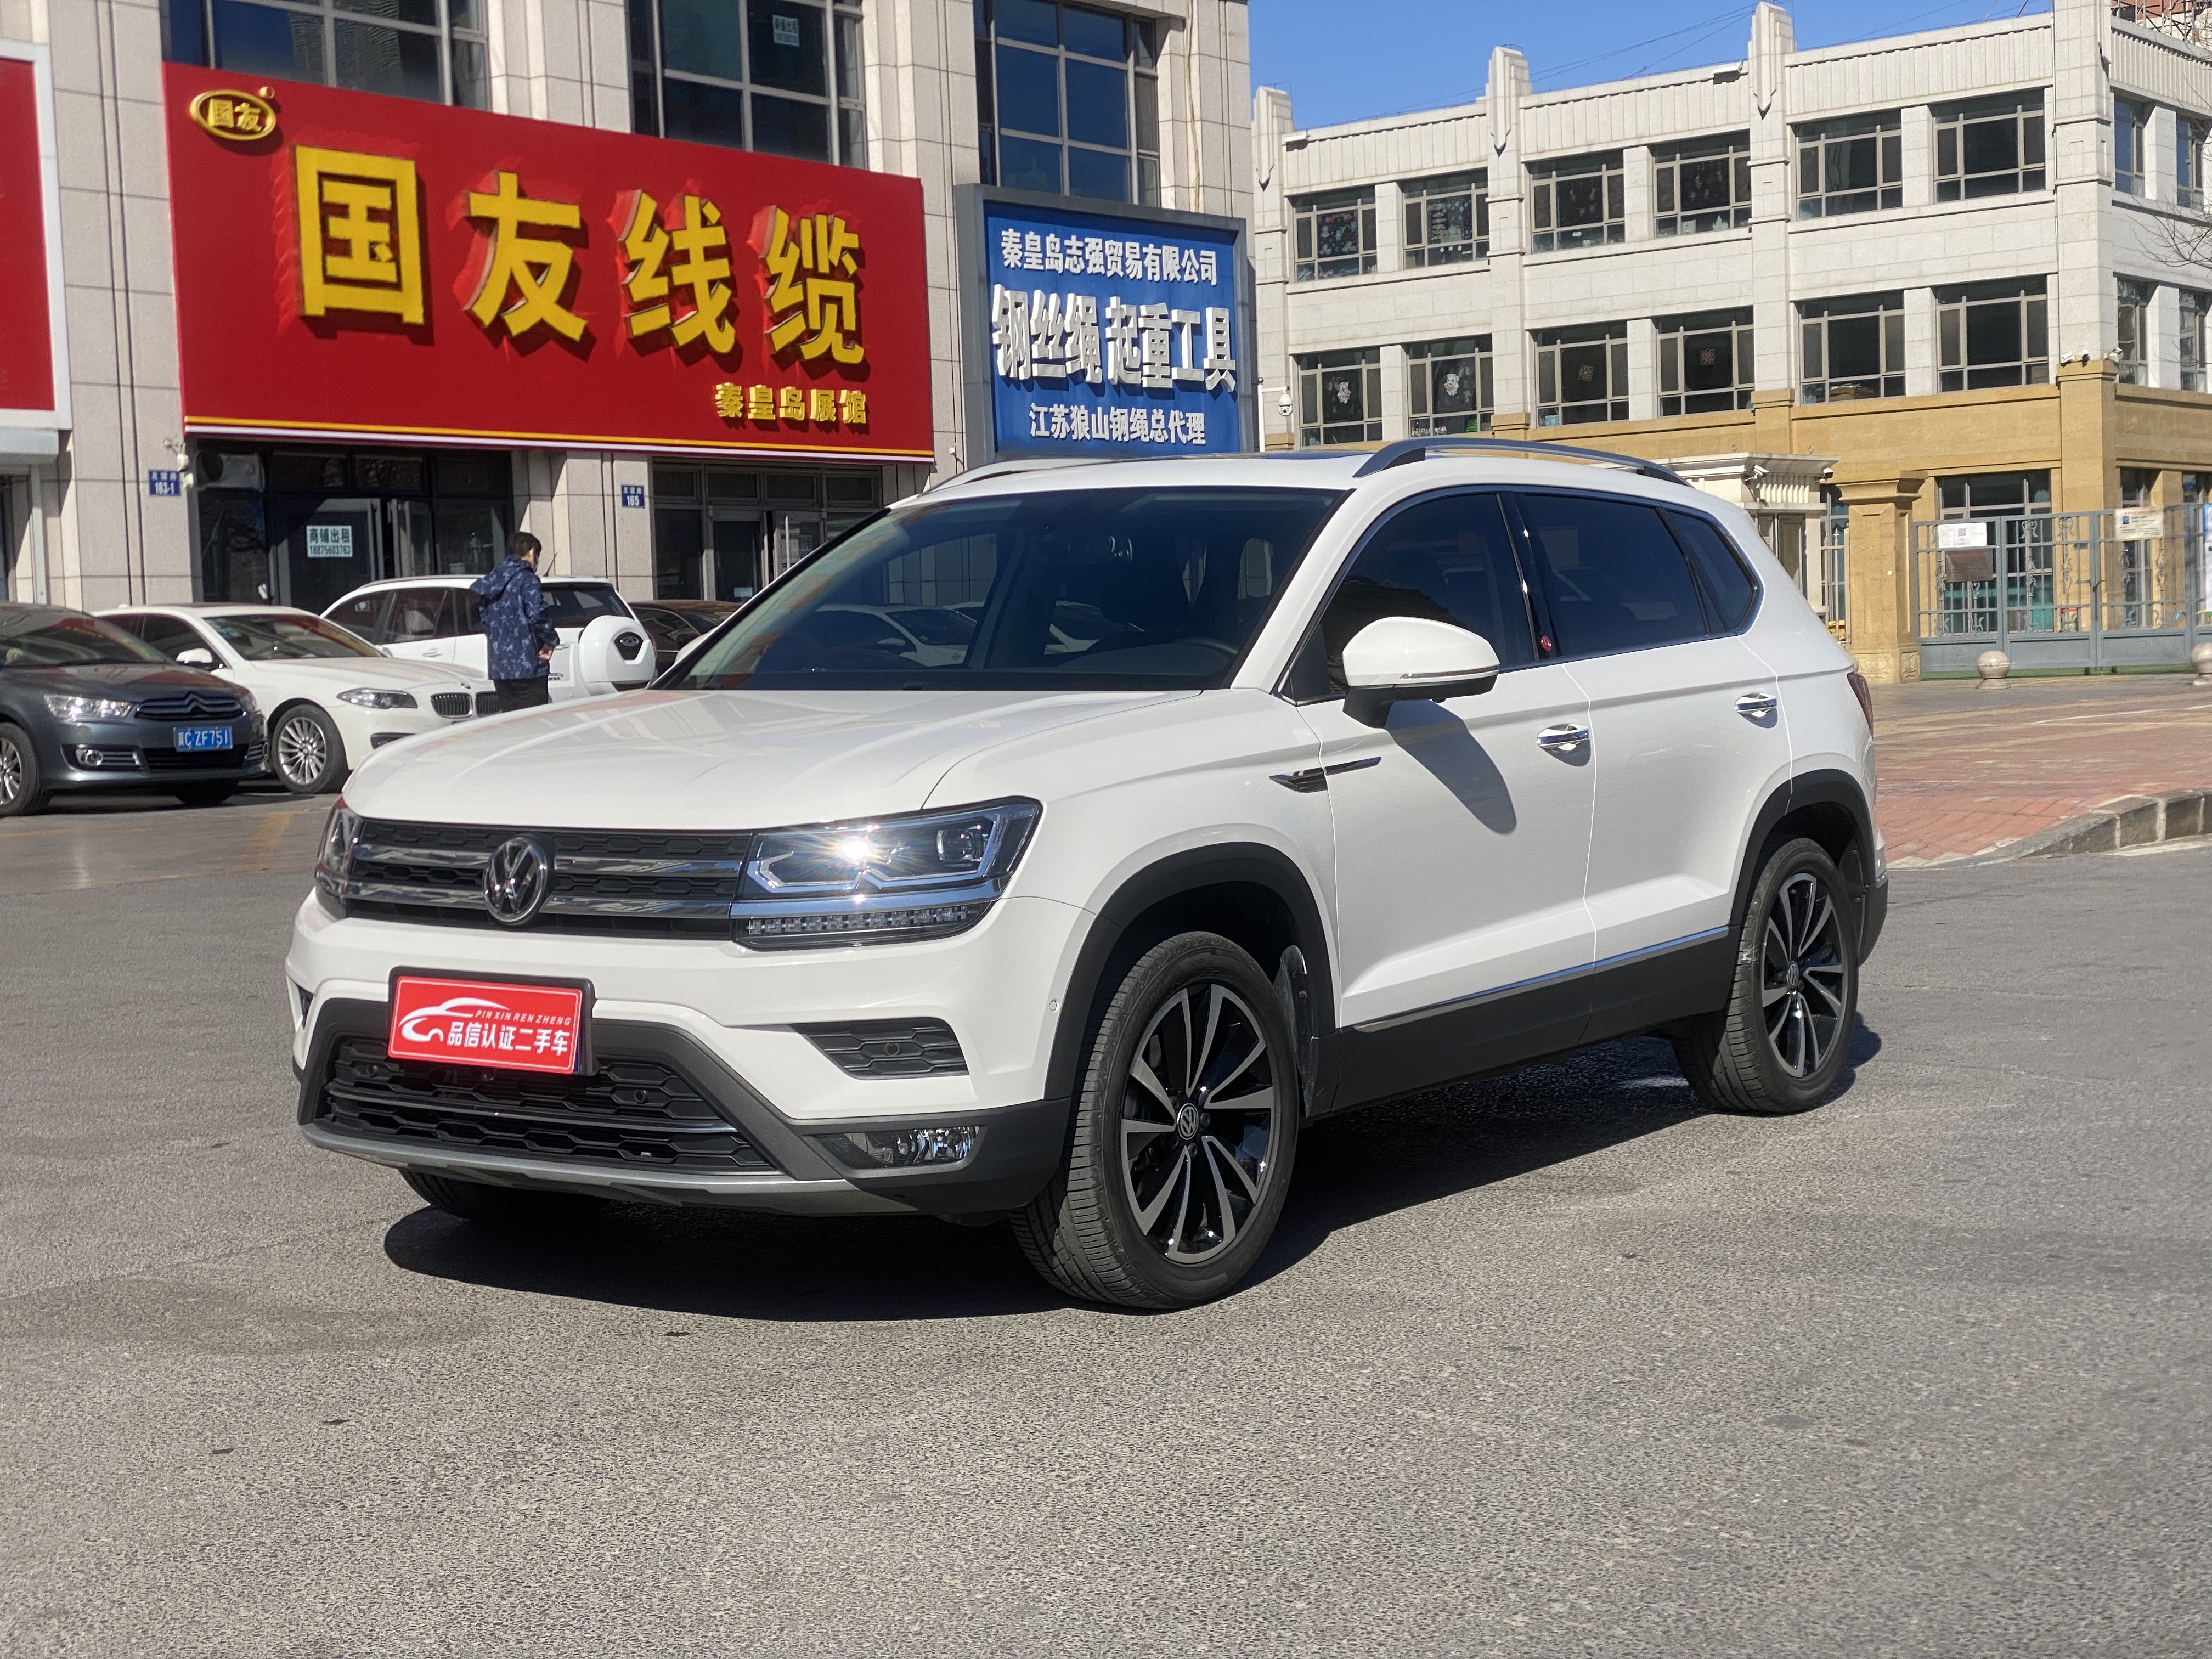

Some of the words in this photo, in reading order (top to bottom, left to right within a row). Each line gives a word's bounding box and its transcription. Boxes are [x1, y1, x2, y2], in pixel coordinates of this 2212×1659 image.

[207, 98, 262, 132] 国友
[294, 145, 865, 364] 国友线缆
[1001, 228, 1217, 286] 秦皇岛志强贸易有限公司
[715, 382, 866, 424] 秦皇岛展馆
[1029, 402, 1206, 445] 江苏狼山钢绳总代理
[626, 495, 640, 506] 165
[446, 1021, 571, 1057] 品信认证二手车
[535, 1014, 572, 1026] ZHENG
